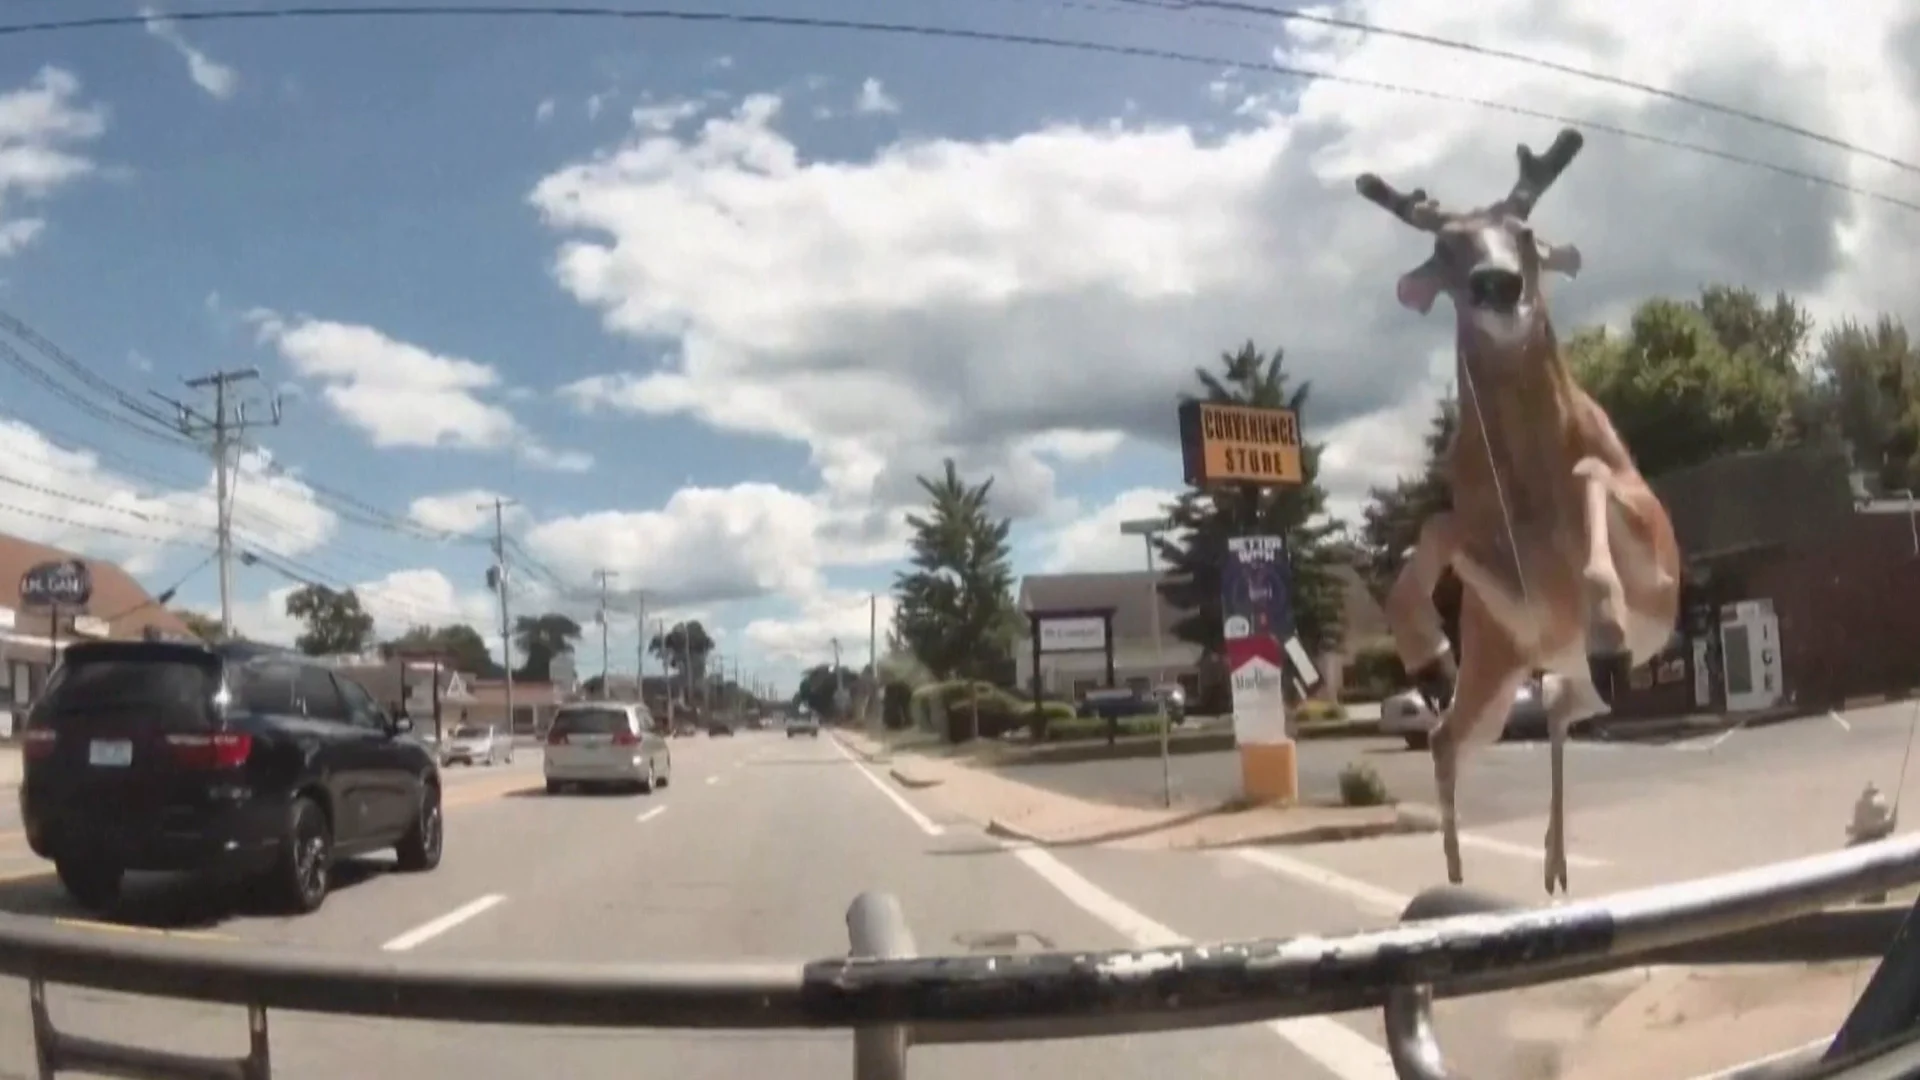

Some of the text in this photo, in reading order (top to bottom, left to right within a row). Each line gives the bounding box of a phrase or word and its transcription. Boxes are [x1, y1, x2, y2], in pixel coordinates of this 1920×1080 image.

[1203, 408, 1296, 446] CONVENIENCE
[1225, 446, 1283, 475] STORE
[1761, 624, 1774, 692] ICE
